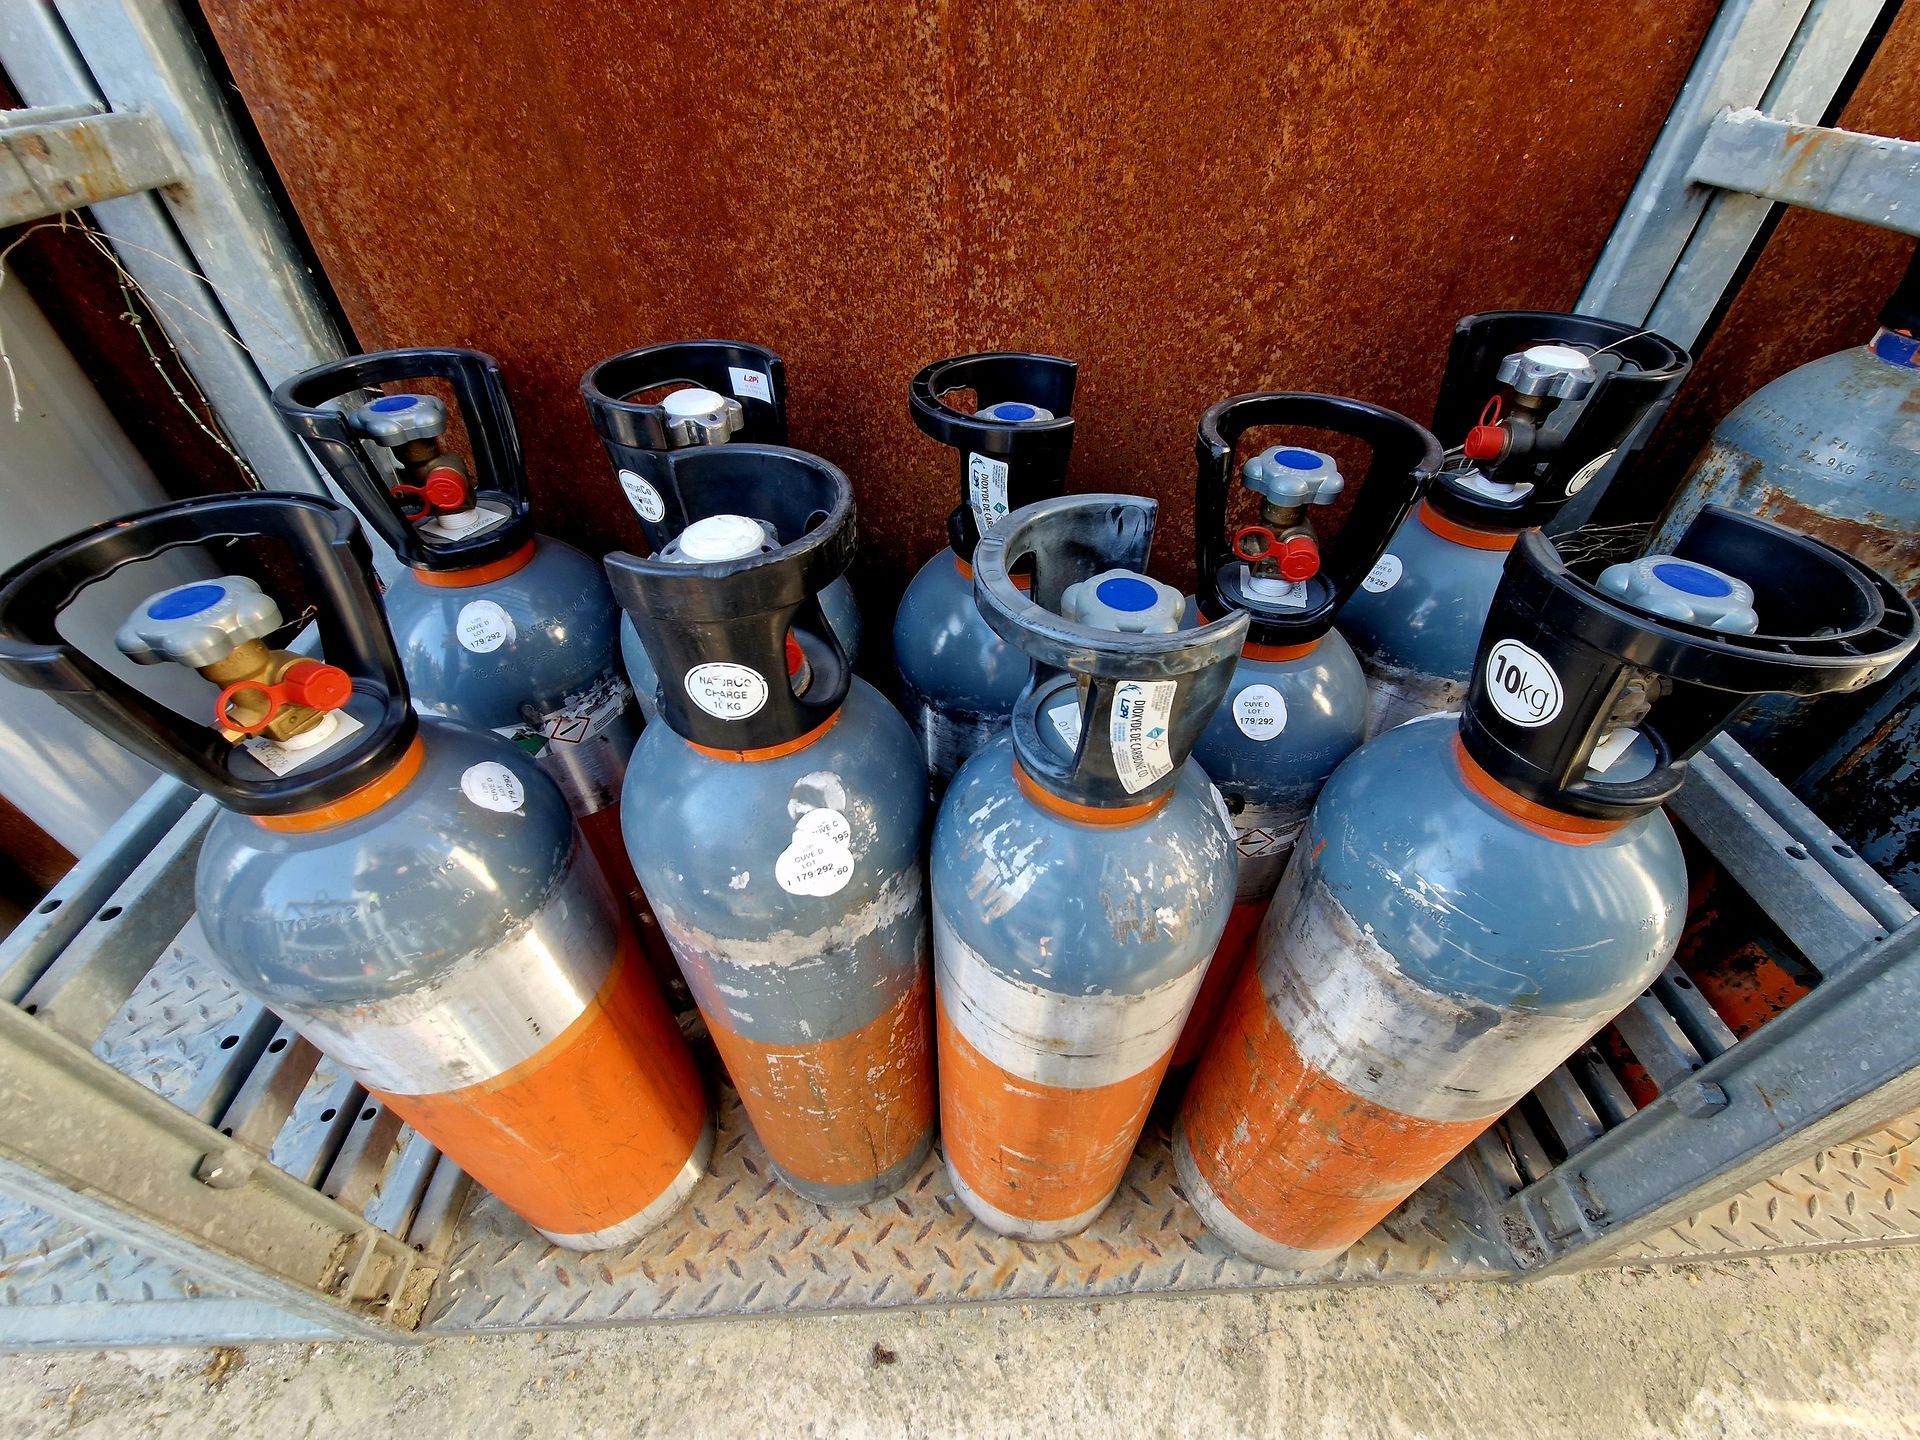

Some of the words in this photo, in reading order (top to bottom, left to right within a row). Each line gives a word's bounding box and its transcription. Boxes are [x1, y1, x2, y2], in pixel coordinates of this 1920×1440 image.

[981, 473, 990, 503] DIOXYDE
[983, 504, 991, 513] DE
[1366, 575, 1389, 588] 79/292
[465, 622, 482, 633] CUVE
[482, 620, 490, 628] D
[1495, 654, 1550, 717] 10kg
[704, 688, 748, 699] CHARGE
[726, 702, 742, 711] KG
[1130, 700, 1147, 732] DIOXYDE
[1239, 717, 1274, 726] 179/292
[1130, 732, 1142, 743] DE
[1130, 743, 1147, 771] CARBONE
[490, 783, 499, 802] CUVE
[794, 851, 816, 863] CUVE
